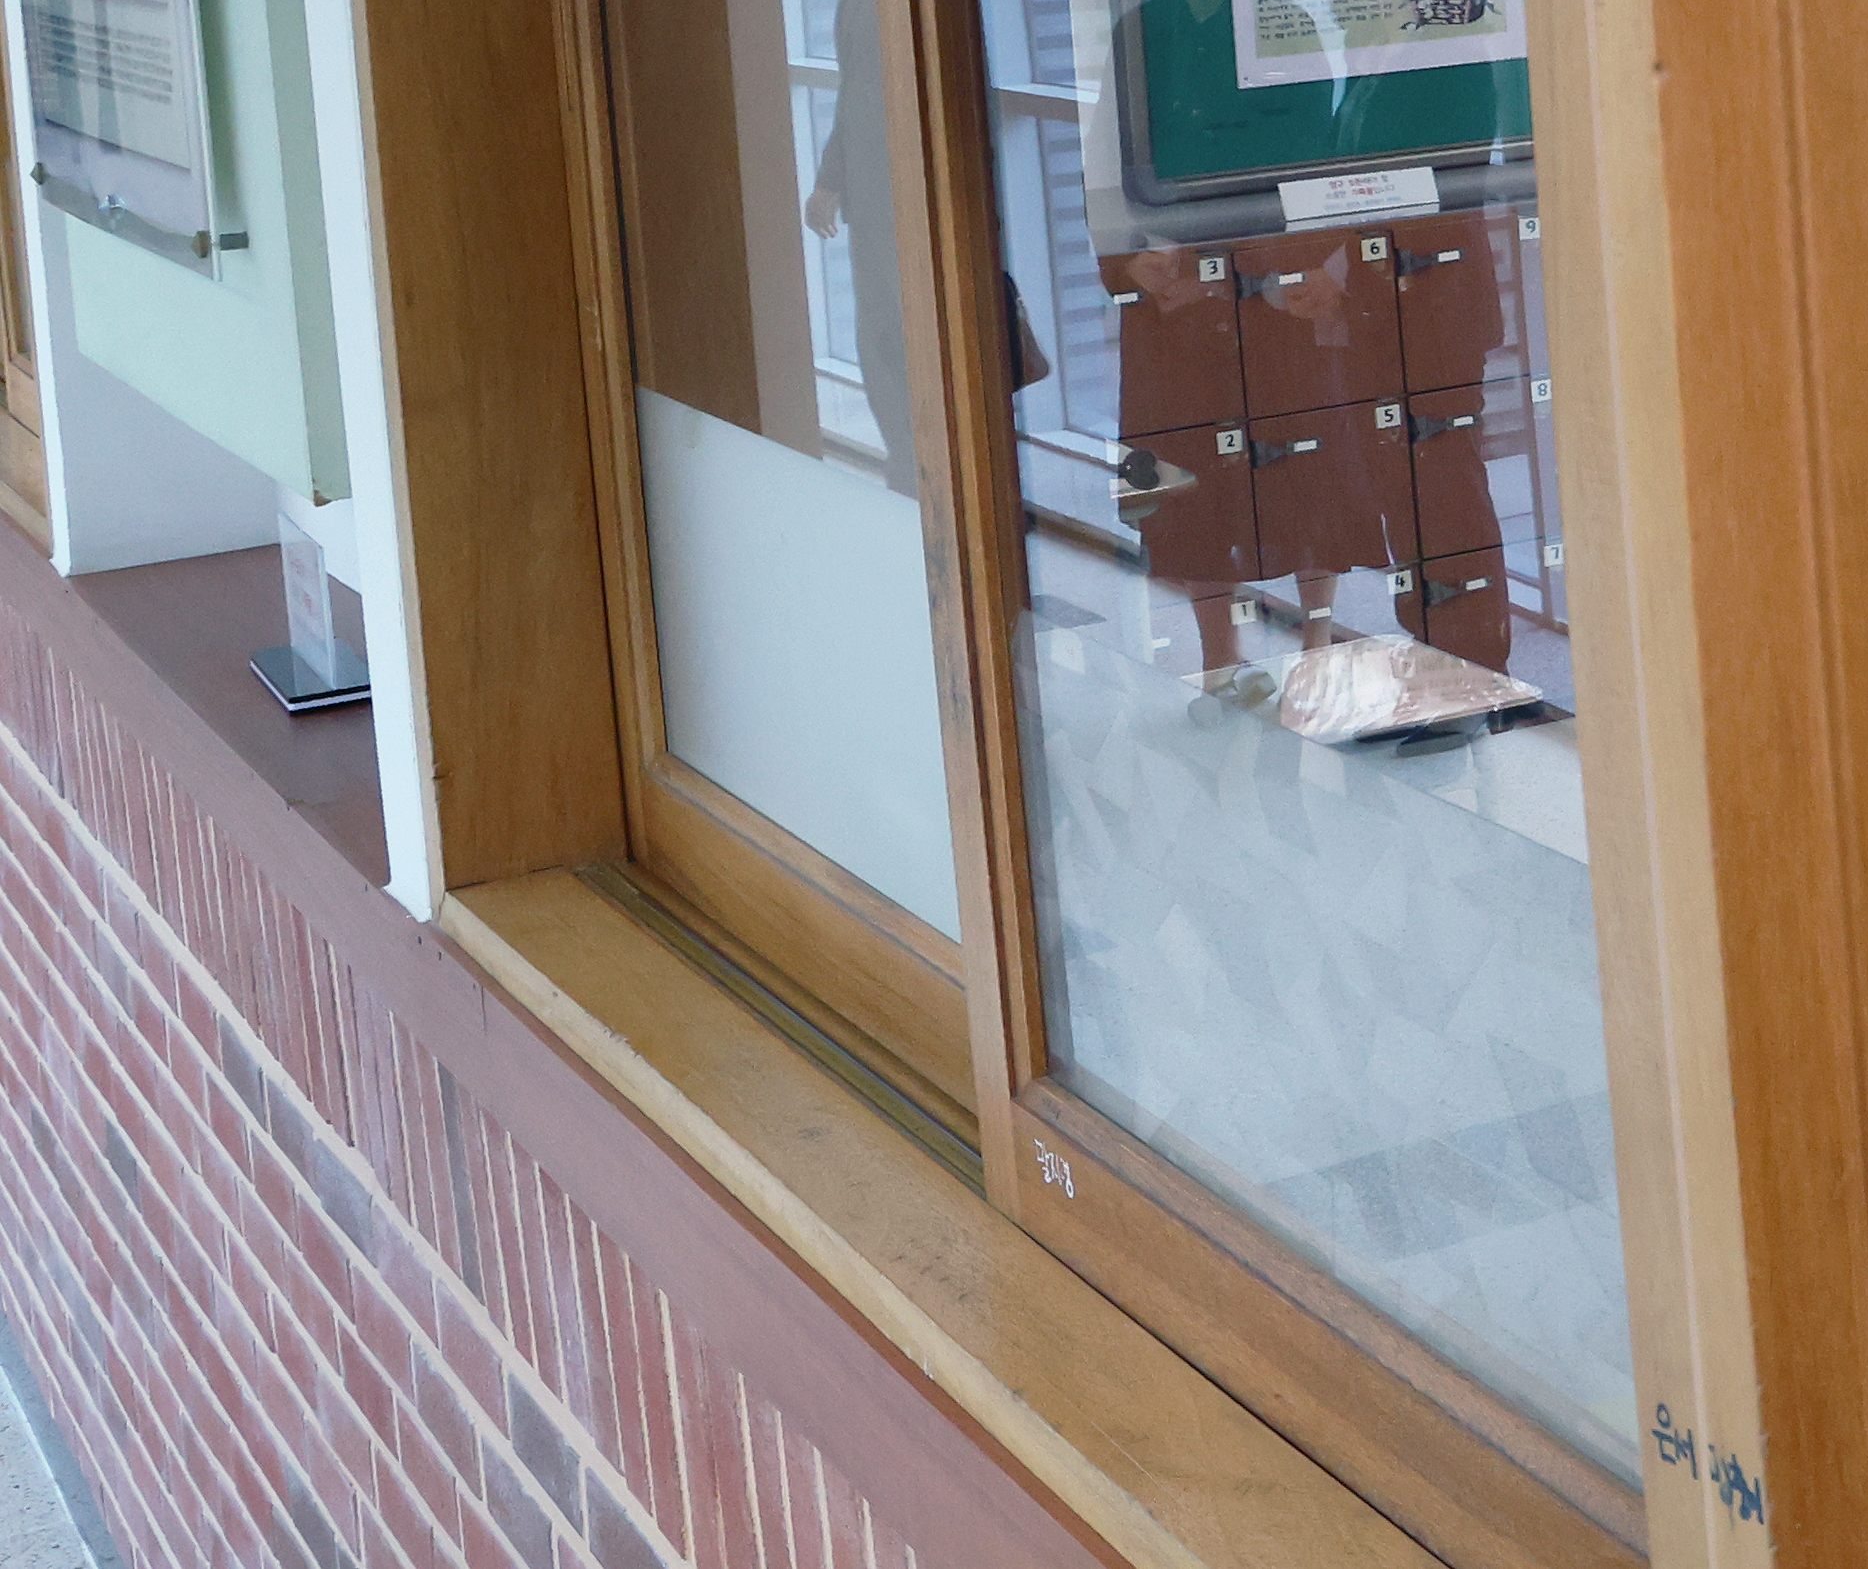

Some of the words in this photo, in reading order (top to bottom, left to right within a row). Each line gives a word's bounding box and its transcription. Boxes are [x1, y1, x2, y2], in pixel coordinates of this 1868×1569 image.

[1525, 219, 1537, 235] 9
[1369, 241, 1381, 257] 6
[1206, 259, 1219, 276] 3
[1536, 382, 1549, 398] 8
[1383, 407, 1395, 424] 5
[1225, 433, 1237, 450] 2
[1550, 545, 1561, 560] 7
[1393, 573, 1406, 590] 4
[1241, 602, 1249, 618] 1
